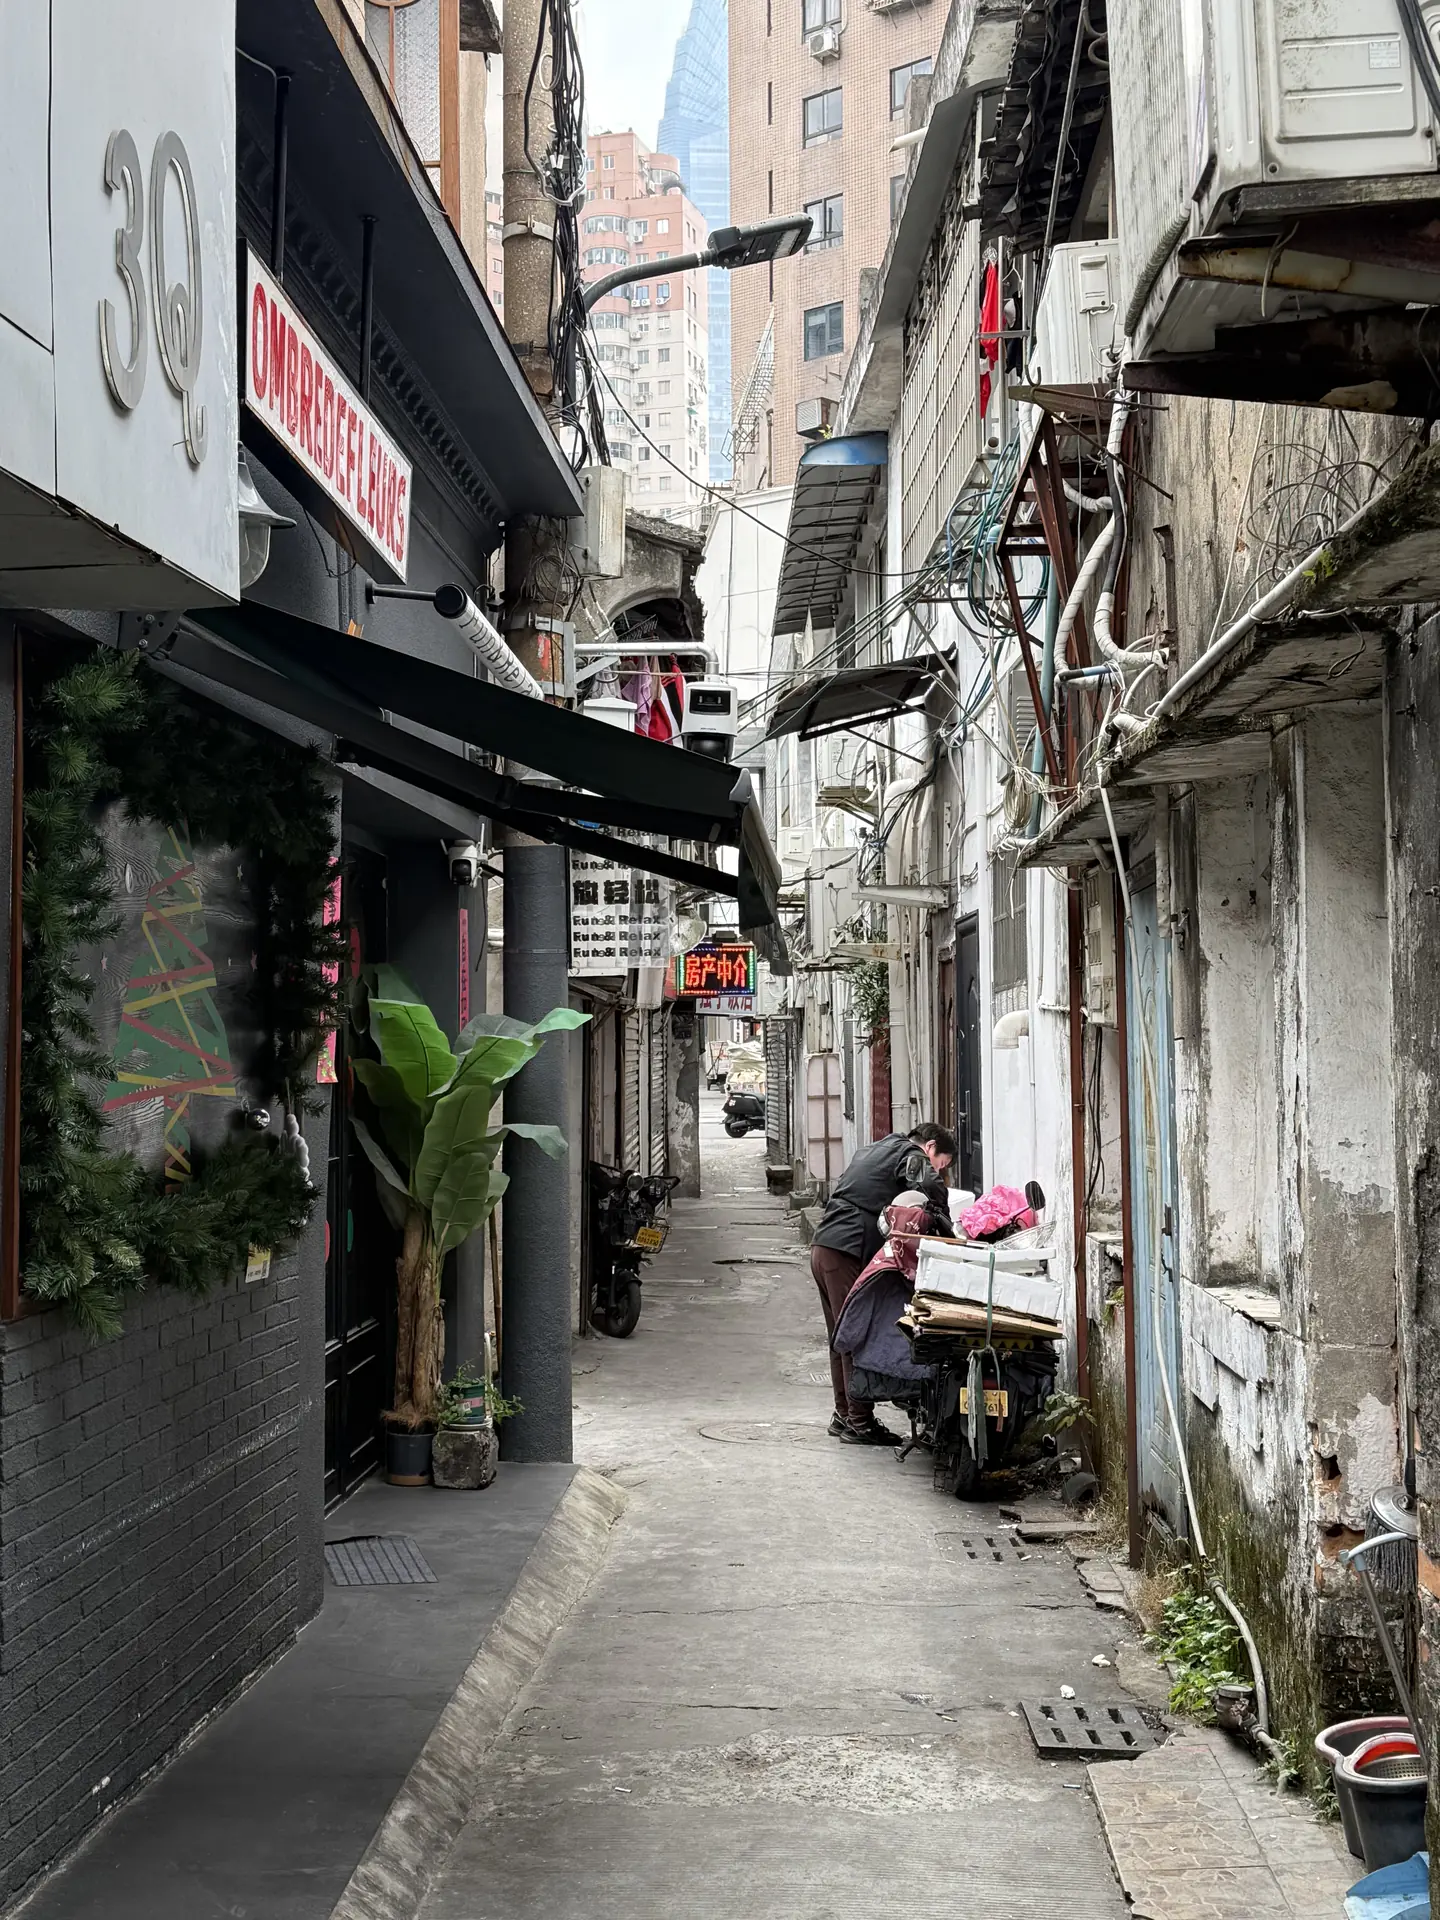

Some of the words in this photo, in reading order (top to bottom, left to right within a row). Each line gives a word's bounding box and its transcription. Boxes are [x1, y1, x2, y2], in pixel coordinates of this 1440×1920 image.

[572, 879, 660, 905] 放轻松
[618, 915, 661, 926] Relax
[618, 931, 661, 942] Relax
[619, 947, 662, 958] Relax
[685, 953, 748, 988] 房产中介
